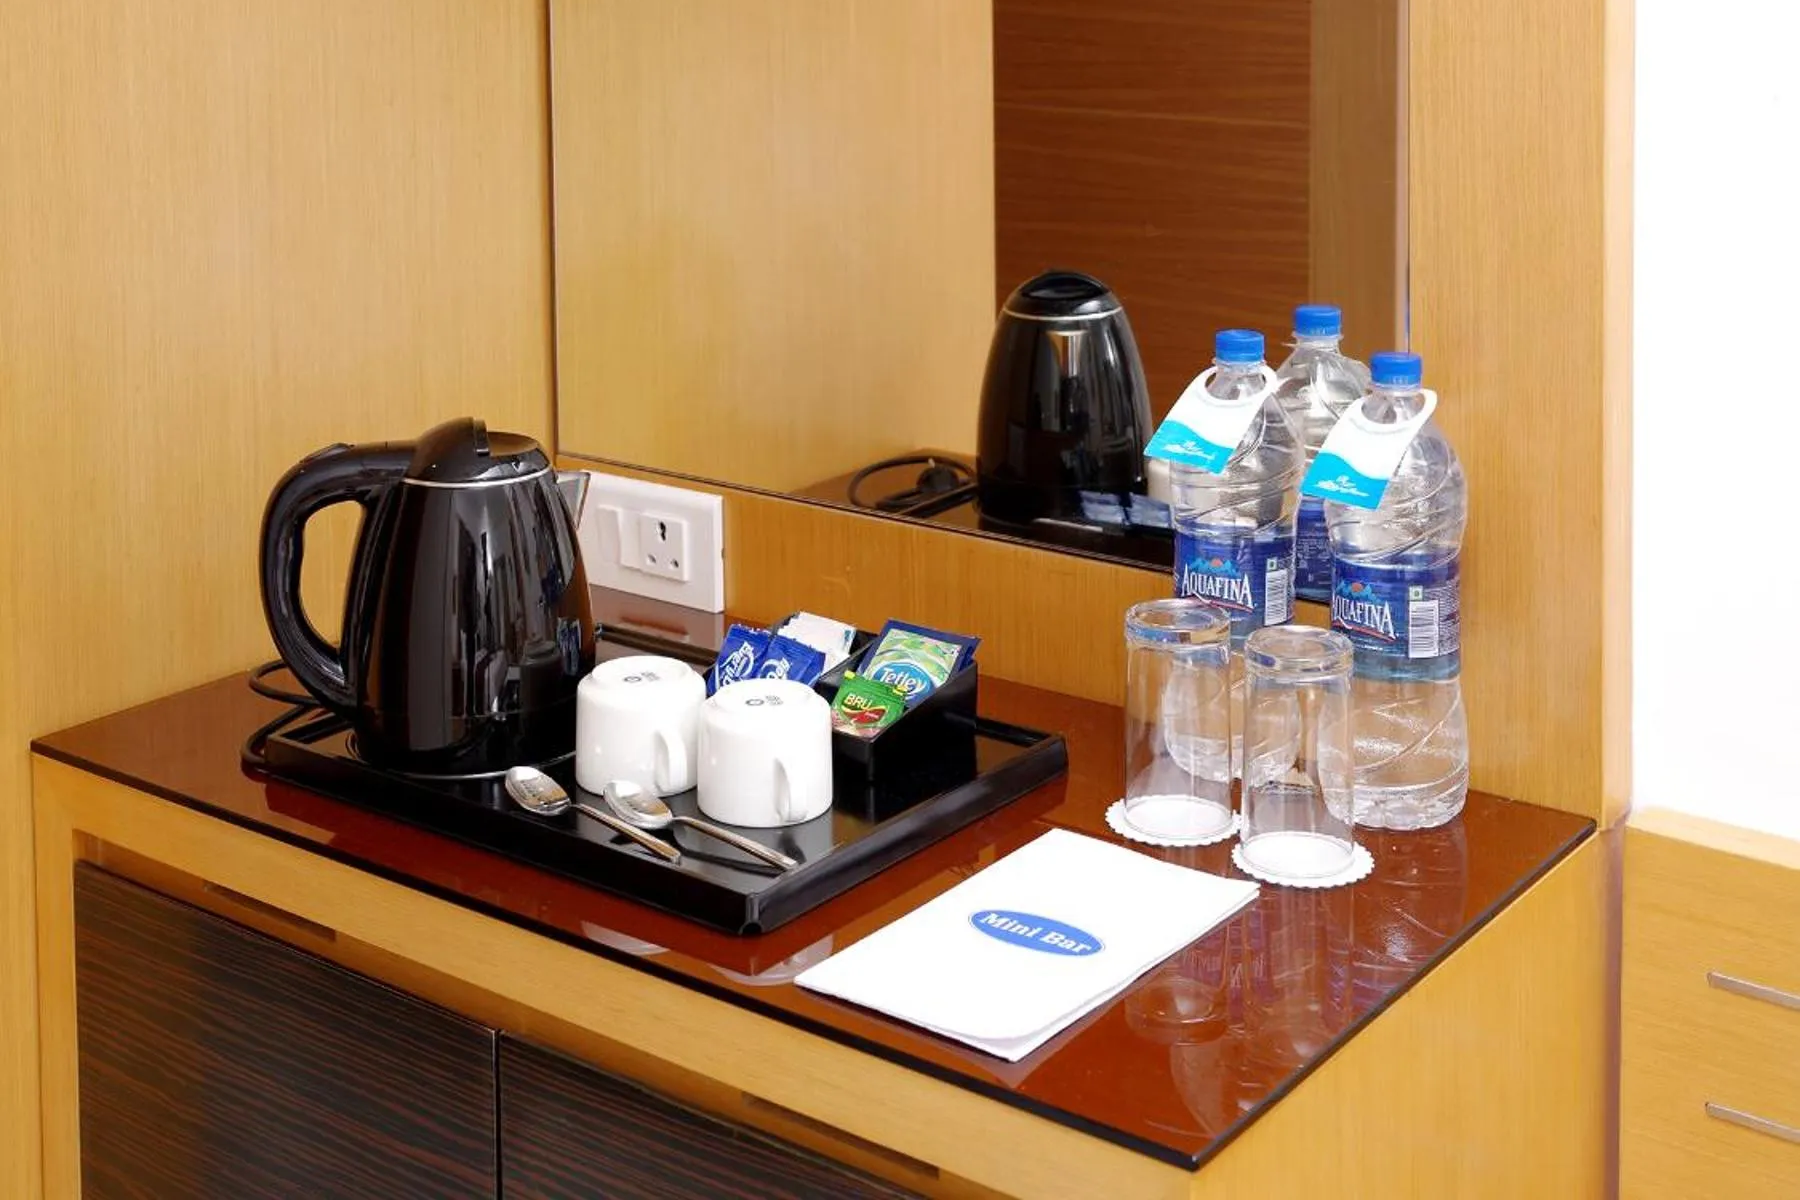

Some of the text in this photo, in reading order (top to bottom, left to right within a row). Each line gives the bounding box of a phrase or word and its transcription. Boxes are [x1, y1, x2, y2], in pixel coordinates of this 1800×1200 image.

[1181, 563, 1254, 609] AQUAFINA
[879, 667, 928, 695] Tetley
[843, 693, 873, 709] BRU
[980, 912, 1093, 953] Mini Bar
